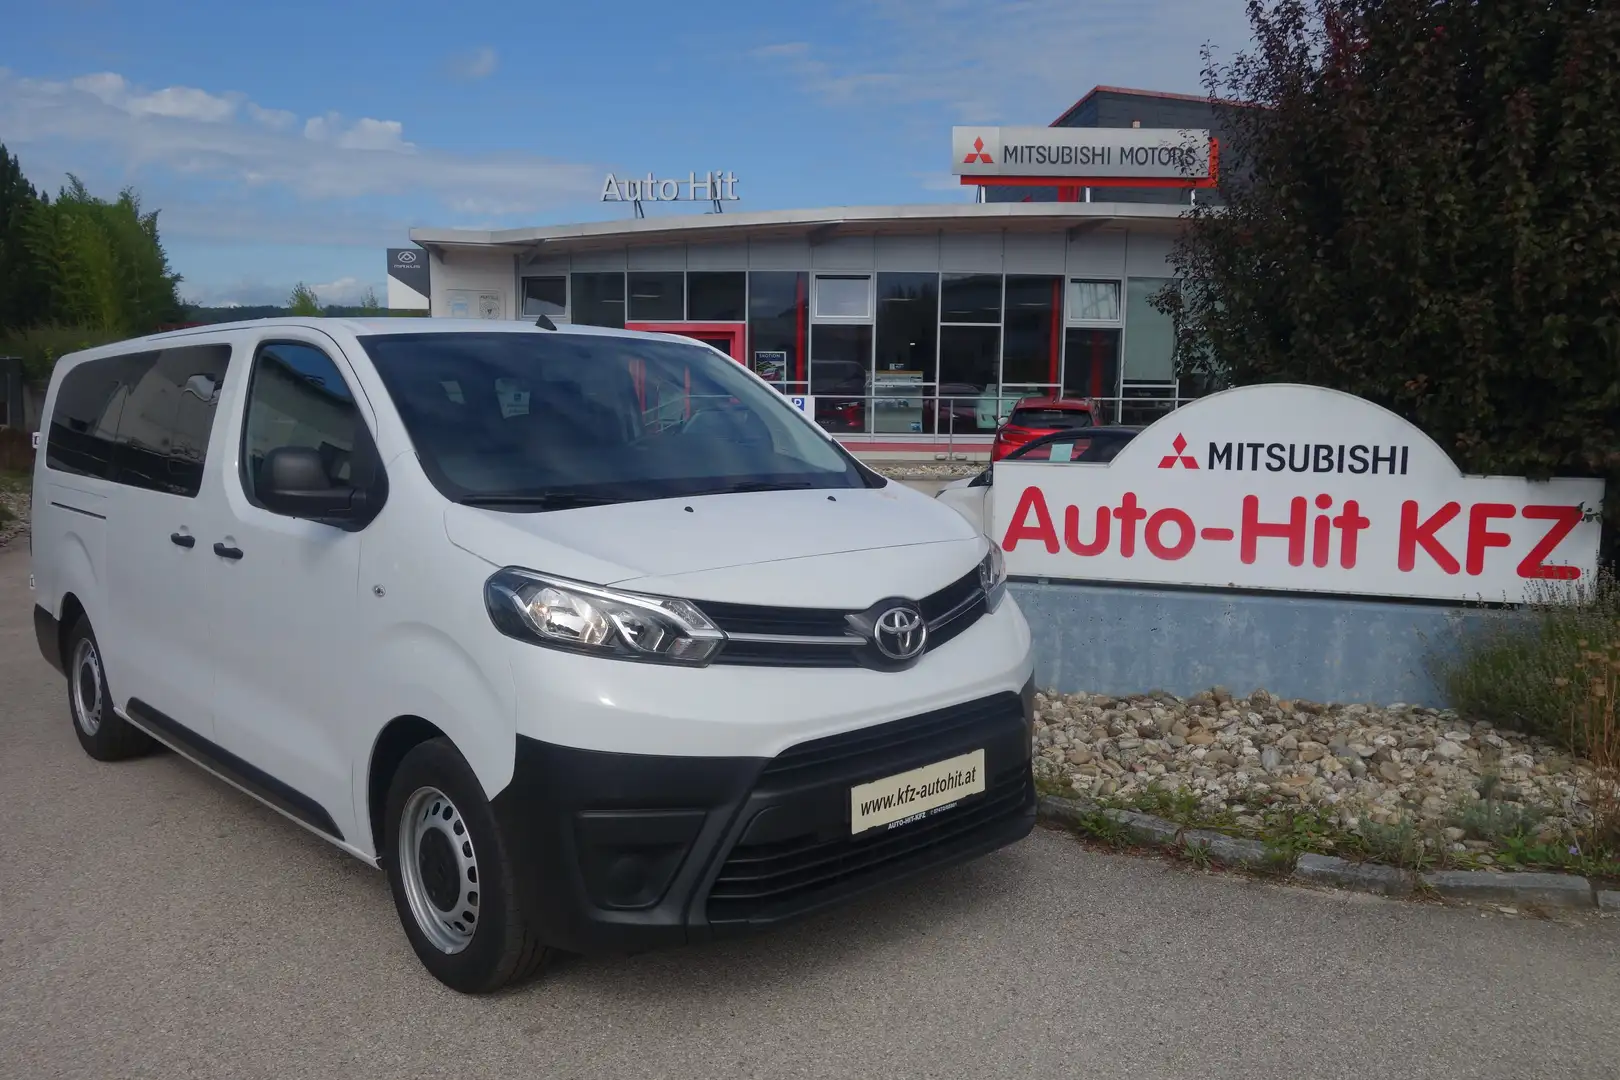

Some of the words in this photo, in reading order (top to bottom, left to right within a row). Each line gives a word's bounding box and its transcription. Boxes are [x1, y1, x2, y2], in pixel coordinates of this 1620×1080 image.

[1003, 145, 1111, 166] MITSUBISHI
[1119, 146, 1197, 167] MOTORS
[600, 172, 680, 201] Auto
[689, 170, 740, 201] Hit
[1208, 441, 1409, 476] MITSUBISHI
[1001, 485, 1371, 570] Auto-Hit
[1397, 499, 1584, 581] KFZ
[860, 765, 977, 817] www.kfz-autohit.at
[887, 811, 927, 830] AUTO-HIT-KFZ
